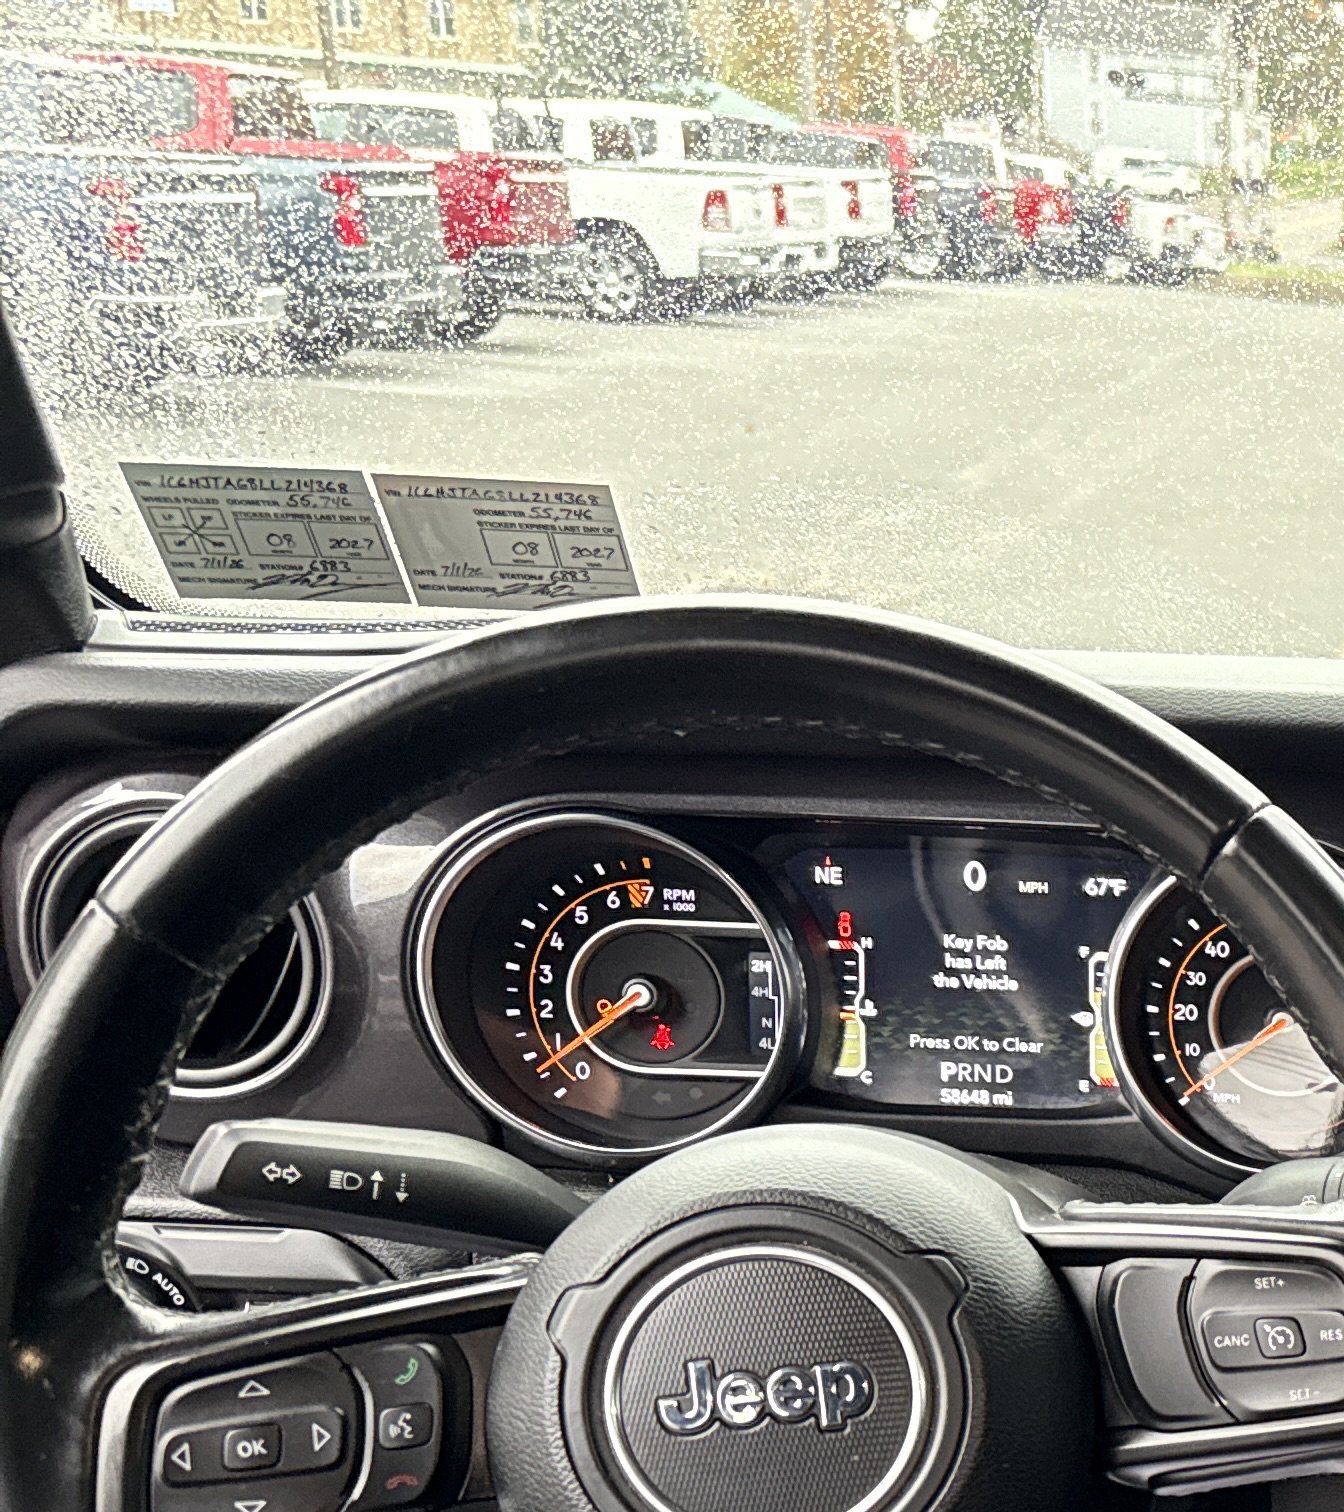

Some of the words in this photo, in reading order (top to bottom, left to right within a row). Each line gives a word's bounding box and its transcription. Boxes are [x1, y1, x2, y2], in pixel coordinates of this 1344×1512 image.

[473, 508, 525, 518] ODOMETER
[477, 520, 517, 529] STICKER
[558, 524, 581, 532] LAST
[266, 533, 296, 548] 08
[329, 537, 374, 550] 2027
[512, 541, 540, 556] 08
[570, 545, 615, 560] 2027
[309, 559, 351, 573] 6883
[413, 569, 437, 577] DATE
[550, 570, 591, 583] 6883
[814, 866, 843, 885] NE
[963, 861, 987, 891] 0
[1018, 881, 1048, 894] MPH
[606, 891, 621, 908] 6
[641, 886, 654, 905] 7
[663, 888, 695, 901] RPM
[673, 903, 696, 912] 1000
[574, 907, 589, 924] 5
[550, 932, 564, 950] 4
[860, 937, 873, 949] H
[943, 934, 972, 952] Key
[976, 935, 1008, 951] Fob
[1204, 941, 1230, 958] 40
[751, 960, 770, 972] 2H
[945, 953, 972, 970] has
[975, 955, 1006, 971] Left
[539, 965, 553, 983] 3
[1186, 971, 1206, 986] 30
[932, 973, 960, 990] the
[962, 974, 1019, 991] Vehicle
[751, 987, 768, 997] 4H
[539, 1000, 554, 1018] 2
[1173, 1004, 1198, 1021] 20
[761, 1018, 772, 1028] N
[759, 1038, 775, 1049] 4L
[910, 1034, 950, 1051] Press
[953, 1036, 979, 1051] OK
[982, 1038, 999, 1051] to
[1003, 1037, 1043, 1054] Clear
[1185, 1043, 1200, 1057] 10
[575, 1061, 591, 1079] 0
[860, 1071, 873, 1085] C
[1079, 1080, 1089, 1092] E
[940, 1088, 989, 1104] 58648
[992, 1090, 1013, 1106] mi
[1213, 1093, 1240, 1104] MPH
[152, 1273, 185, 1306] AUTO
[1214, 1334, 1250, 1348] CANC
[1320, 1328, 1343, 1341] RES
[658, 1357, 875, 1436] Jeep
[237, 1438, 267, 1458] OK
